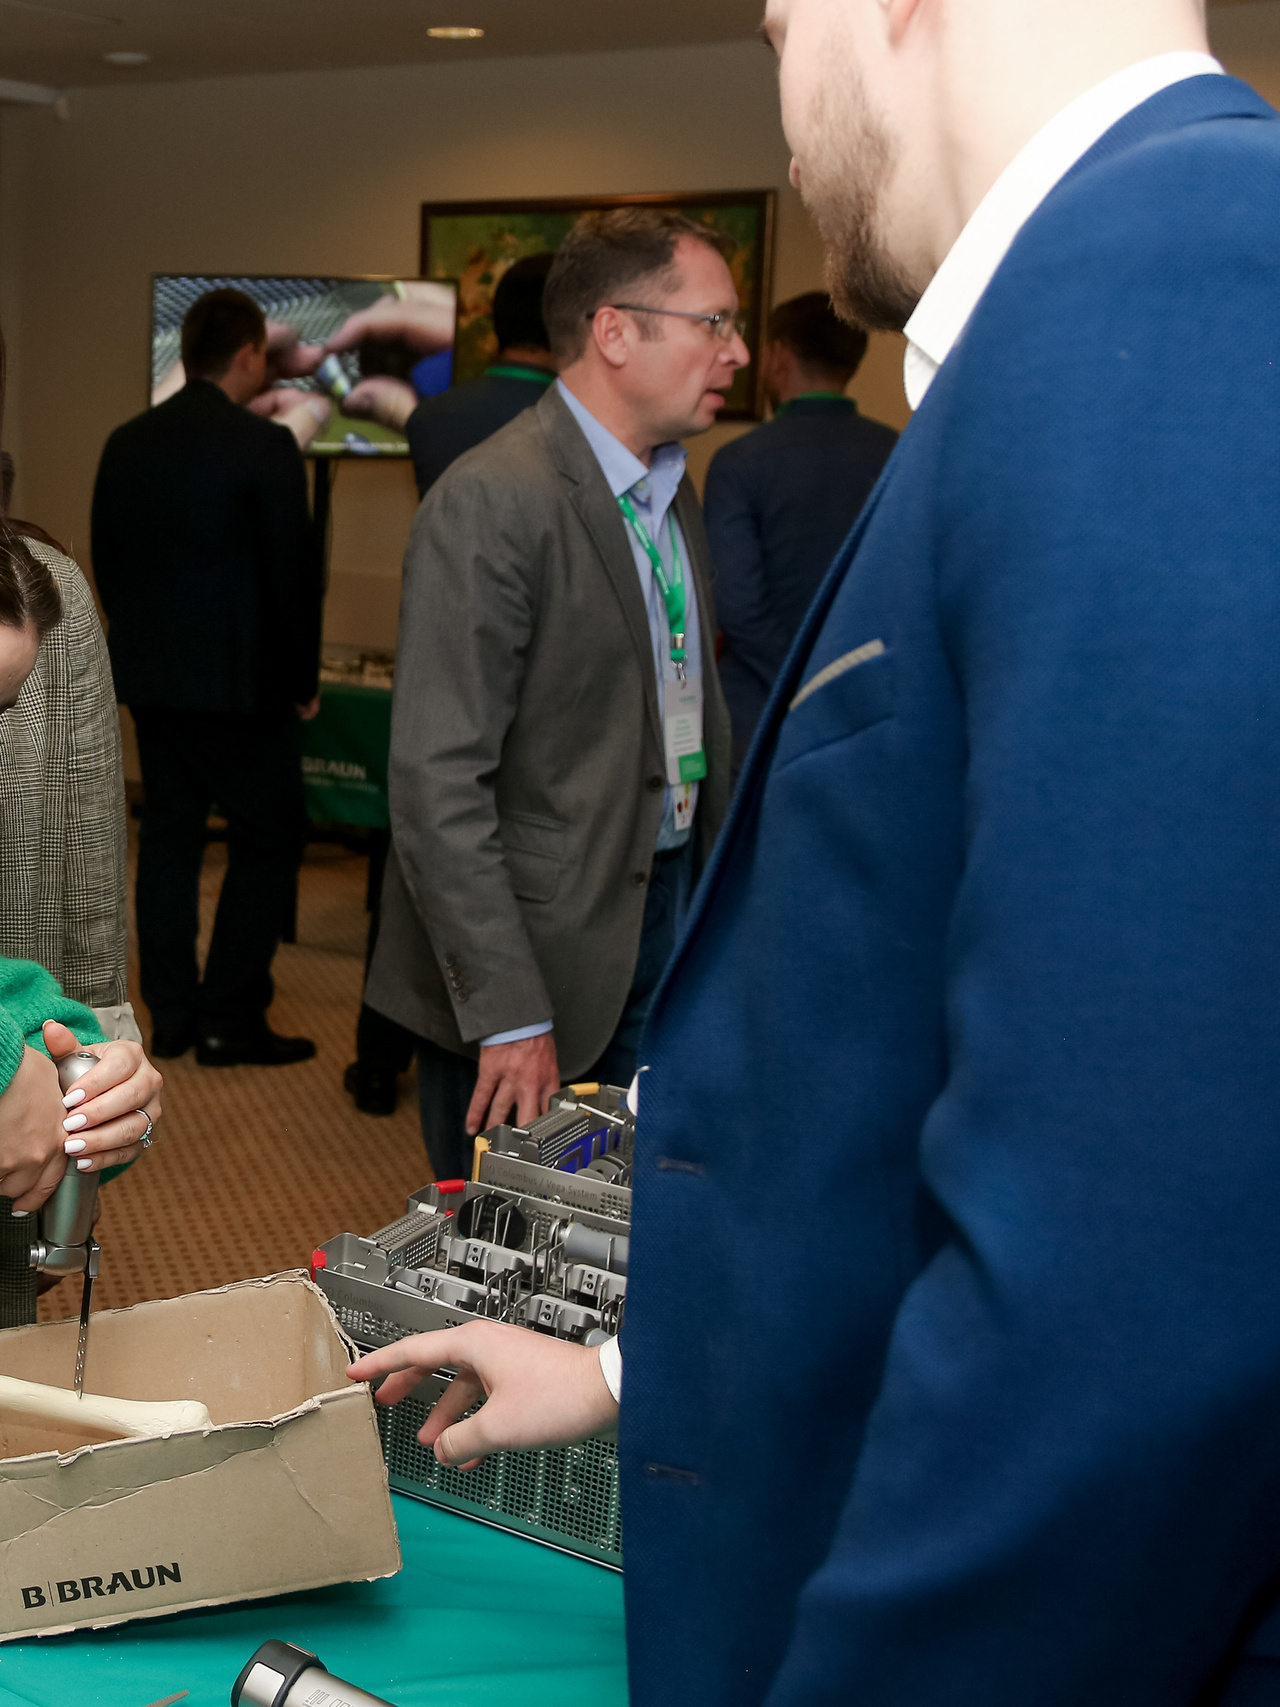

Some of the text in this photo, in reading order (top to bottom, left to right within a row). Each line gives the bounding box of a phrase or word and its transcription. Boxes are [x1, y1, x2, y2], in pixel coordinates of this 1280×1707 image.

[498, 1167, 537, 1185] Columbus
[546, 1179, 566, 1192] Vega
[569, 1187, 598, 1200] System
[21, 1562, 182, 1609] B BRAUN
